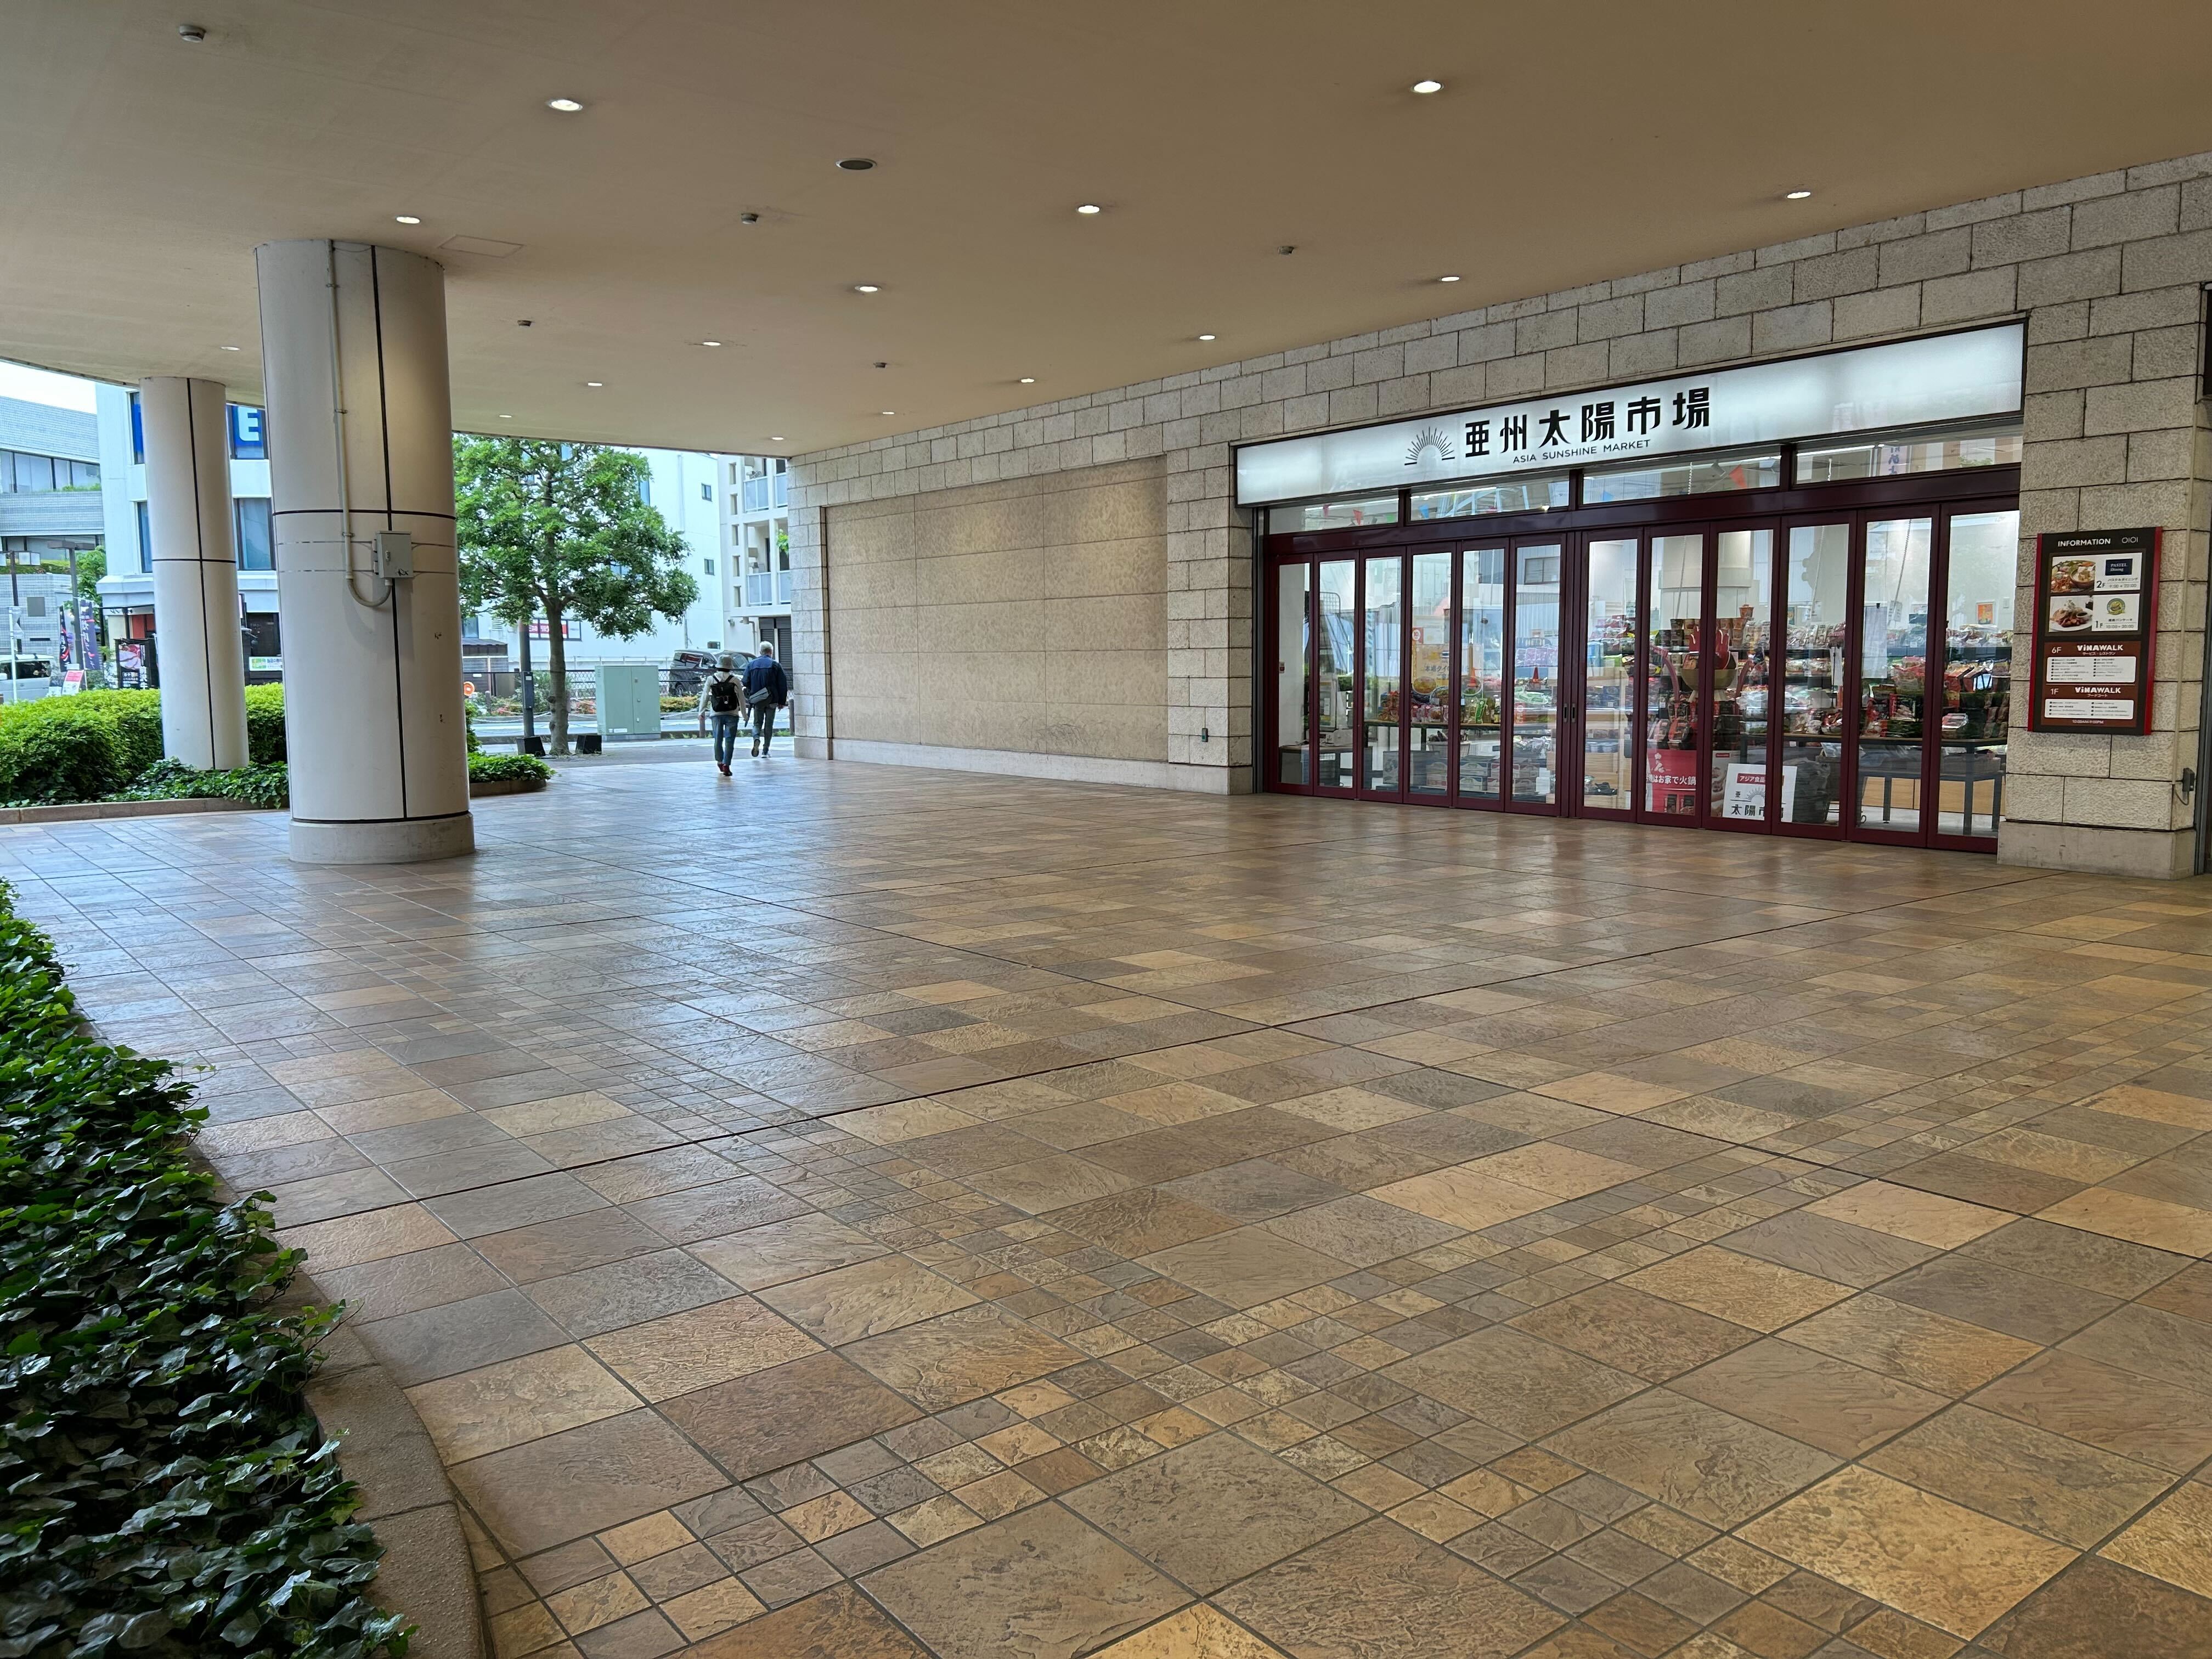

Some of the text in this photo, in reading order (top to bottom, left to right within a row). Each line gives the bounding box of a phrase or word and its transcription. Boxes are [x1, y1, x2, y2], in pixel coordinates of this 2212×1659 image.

[1465, 387, 1709, 458] 亜州太陽市場
[1513, 439, 1651, 464] ASIA SUNSHINE MARKET
[2058, 538, 2111, 547] INFORMATION
[2096, 580, 2106, 589] 2F
